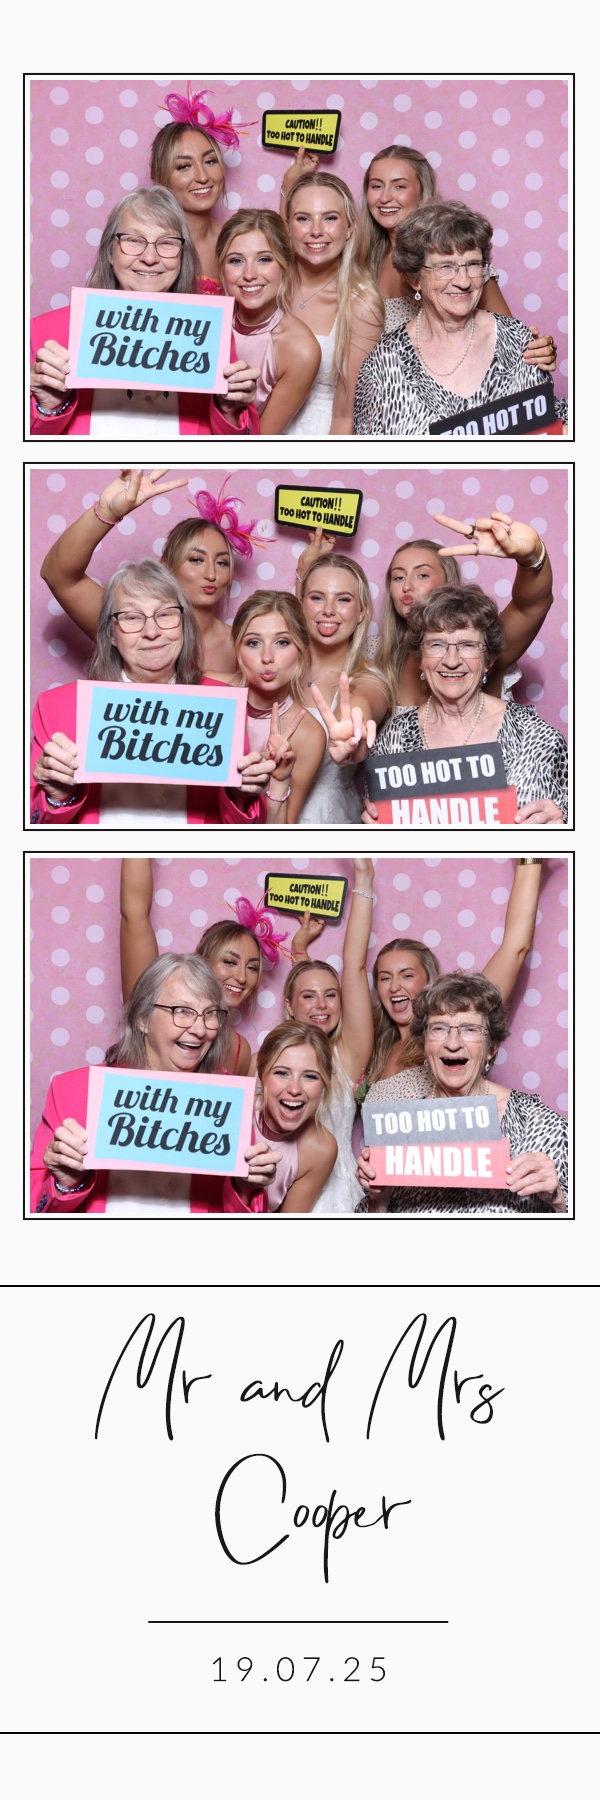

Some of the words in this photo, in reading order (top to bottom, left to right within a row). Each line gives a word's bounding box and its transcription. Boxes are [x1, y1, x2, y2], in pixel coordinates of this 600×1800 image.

[267, 130, 280, 139] TOO
[281, 131, 295, 141] HOT
[296, 132, 305, 142] TO
[305, 133, 334, 146] HANDLE
[285, 118, 322, 131] CAUTION!!
[95, 305, 159, 334] with
[165, 317, 211, 346] my
[89, 332, 211, 374] Bitches
[440, 421, 480, 435] OO
[482, 404, 520, 436] HOT
[522, 395, 547, 420] TO
[280, 507, 294, 516] TOO
[295, 509, 311, 520] HOT
[312, 511, 322, 522] TO
[323, 512, 354, 528] HANDLE
[300, 496, 342, 511] CAUTION!!
[103, 697, 169, 727] with
[175, 709, 224, 739] my
[97, 725, 224, 767] Bitches
[375, 764, 417, 790] TOO
[420, 757, 463, 785] HOT
[466, 754, 496, 778] TO
[391, 796, 501, 824] HANDLE
[269, 893, 284, 902] TOO
[284, 895, 300, 905] HOT
[301, 896, 310, 907] TO
[311, 898, 340, 912] HANDLE
[289, 883, 329, 897] CAUTION!!
[113, 1084, 179, 1114] with
[184, 1097, 232, 1128] my
[372, 1112, 413, 1135] TOO
[416, 1107, 457, 1132] HOT
[461, 1105, 490, 1129] TO
[107, 1112, 231, 1157] Bitches
[385, 1145, 493, 1178] HANDLE
